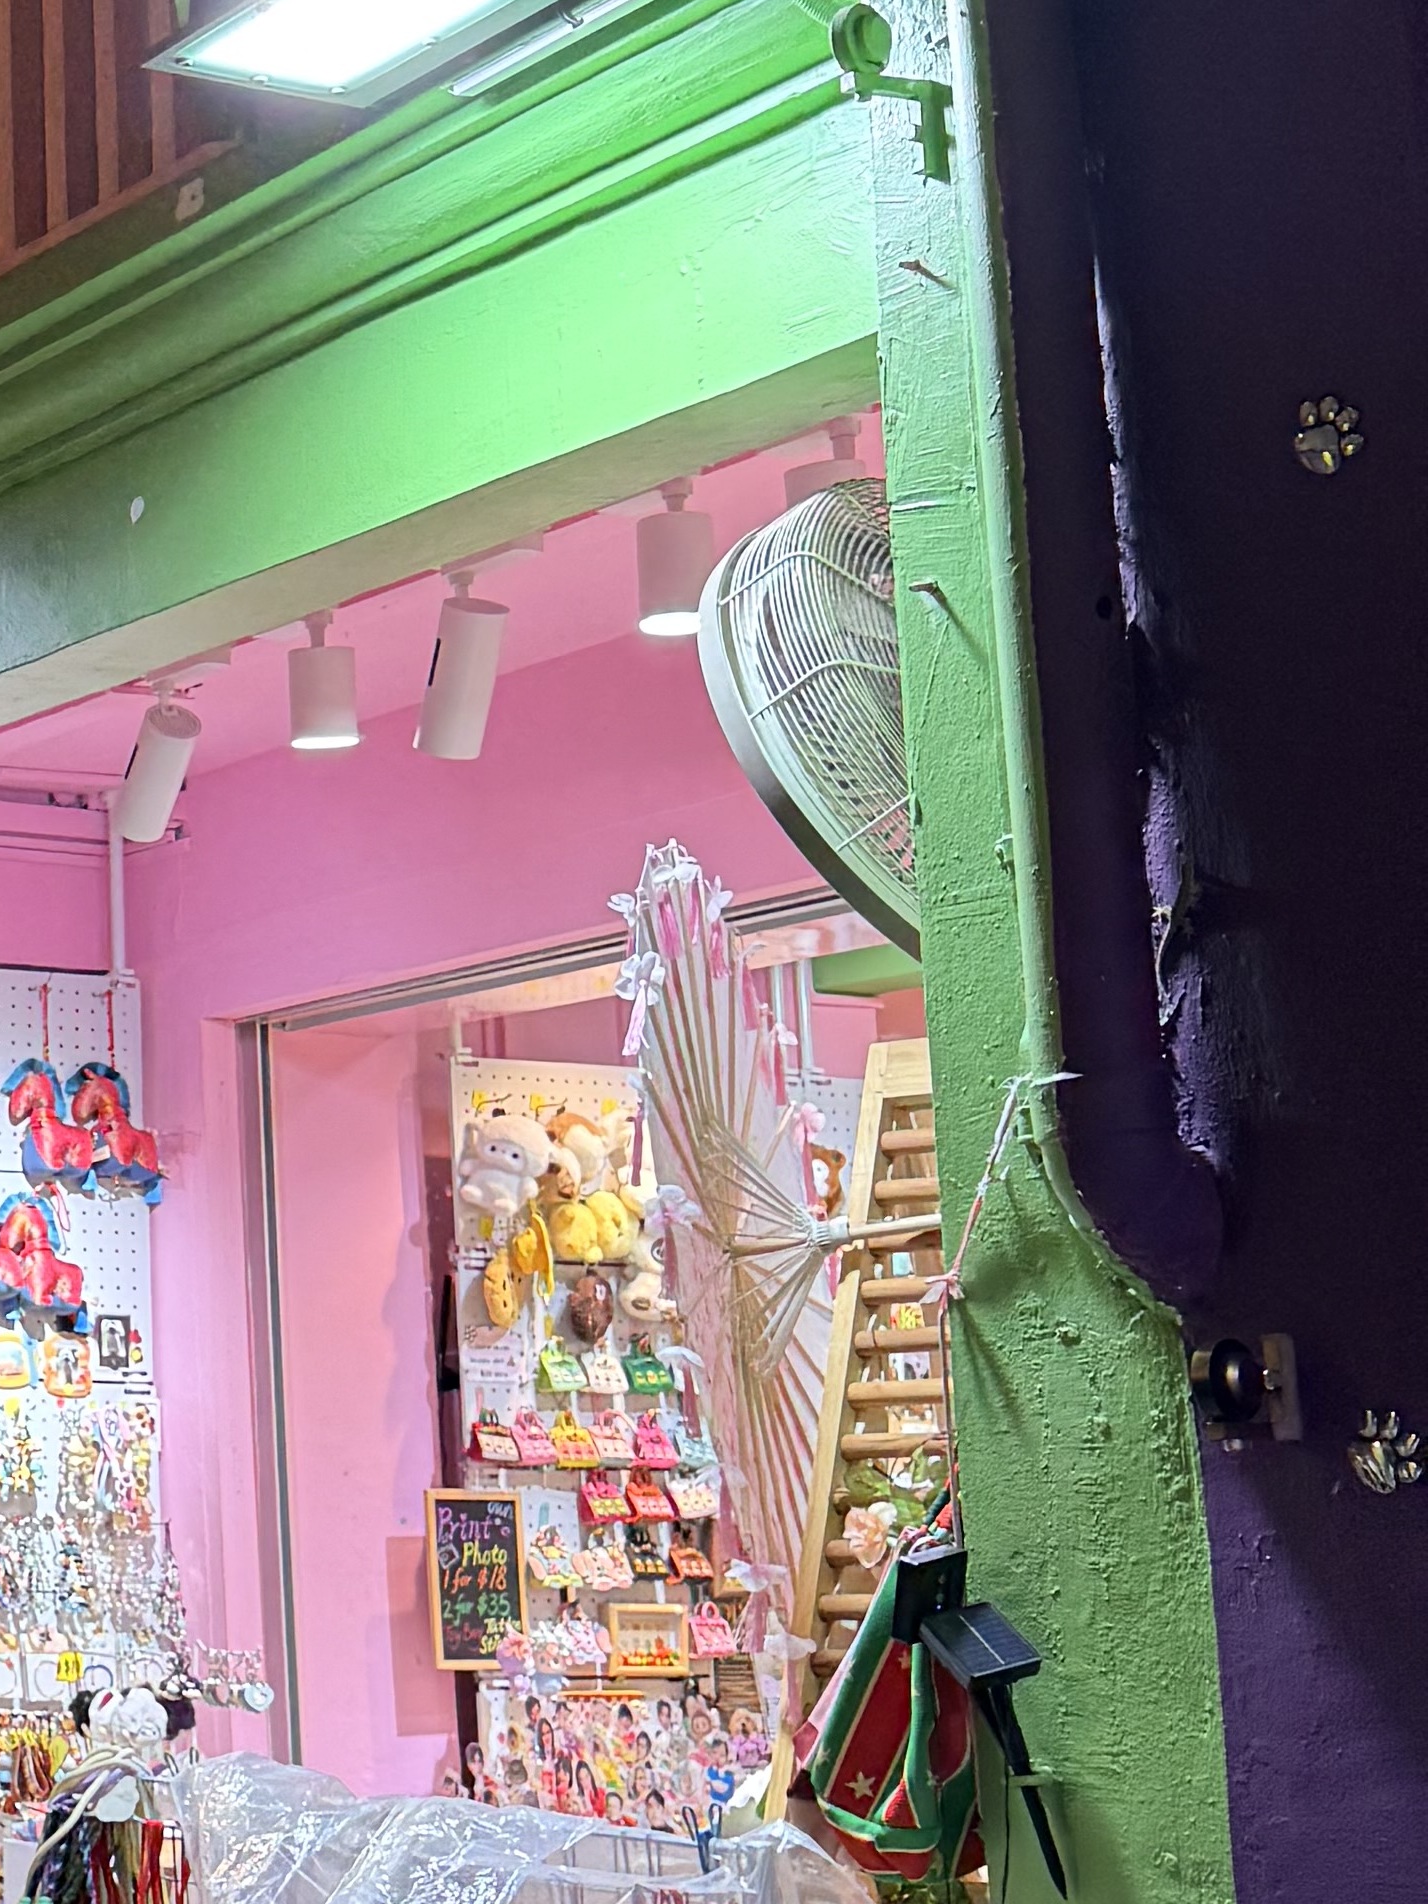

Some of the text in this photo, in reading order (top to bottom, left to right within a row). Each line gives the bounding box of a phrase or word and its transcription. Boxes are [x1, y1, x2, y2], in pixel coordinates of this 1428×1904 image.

[438, 1507, 493, 1542] Print
[462, 1540, 508, 1567] Photo
[451, 1567, 472, 1594] for
[477, 1565, 507, 1591] $18
[443, 1599, 454, 1618] 2
[477, 1592, 510, 1617] $35
